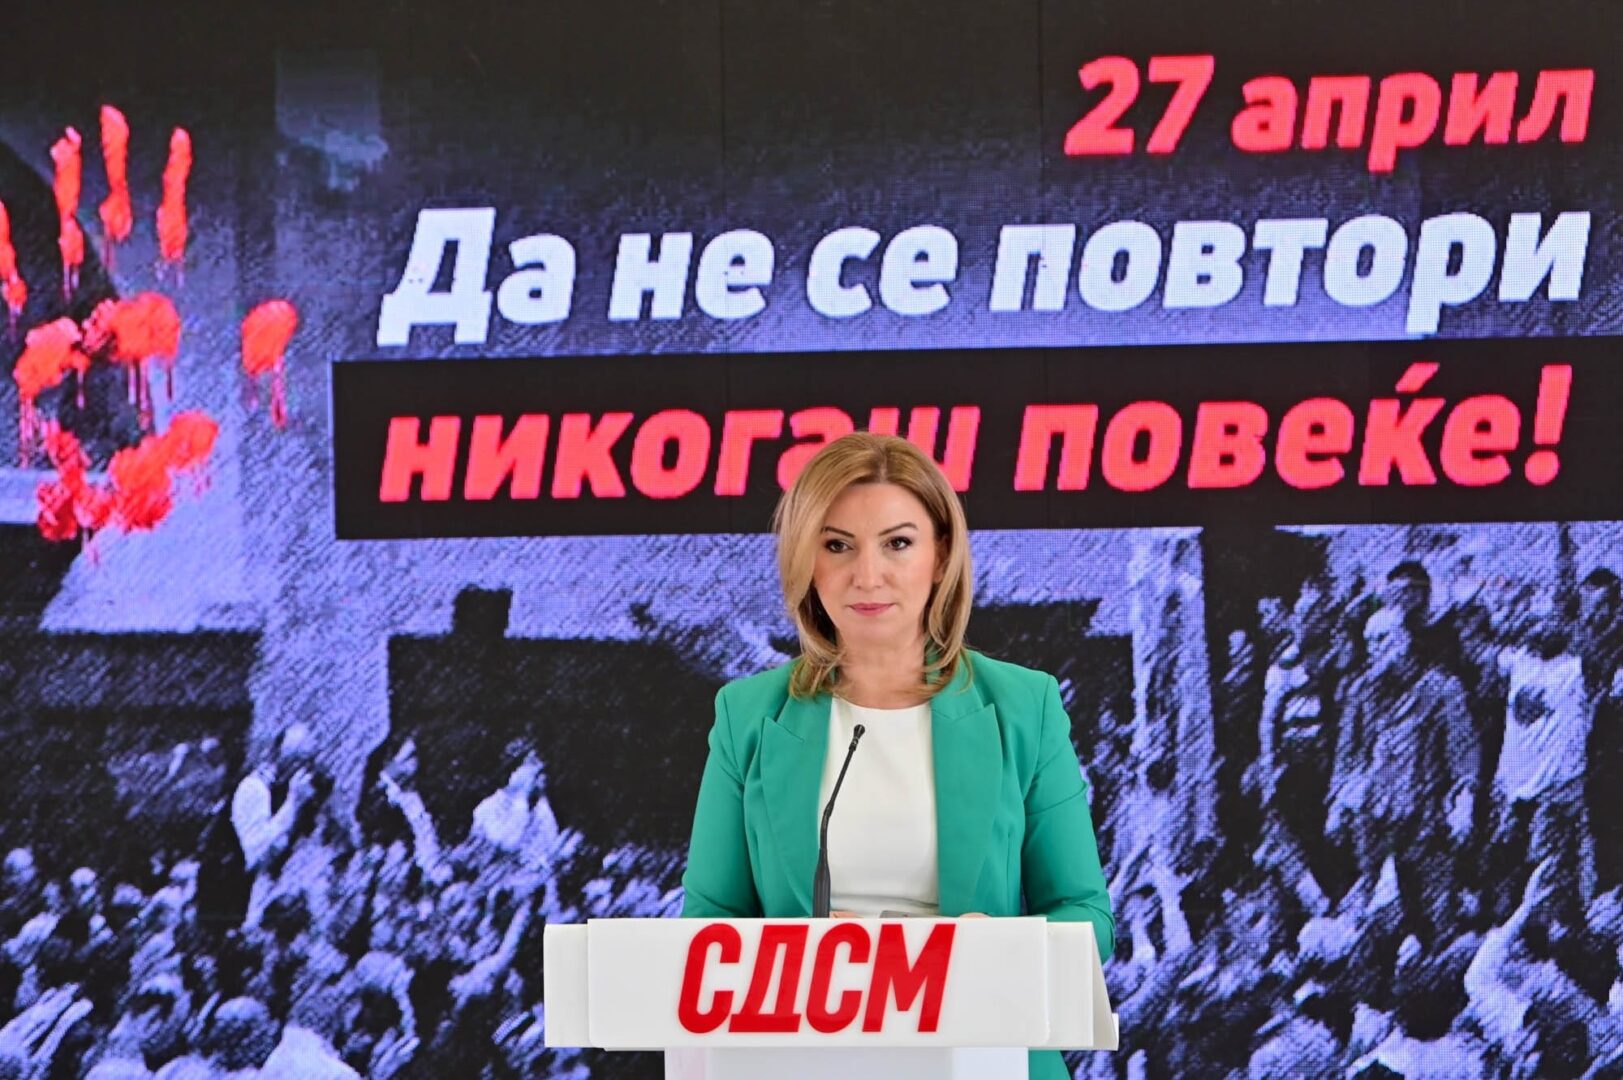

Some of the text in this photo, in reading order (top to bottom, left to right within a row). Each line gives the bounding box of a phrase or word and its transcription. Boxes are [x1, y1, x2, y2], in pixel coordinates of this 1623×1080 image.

[1064, 55, 1594, 172] 27 април
[378, 207, 1590, 347] Да не се повтори
[1014, 363, 1572, 492] повеќе!
[678, 923, 955, 1033] СДСМ
